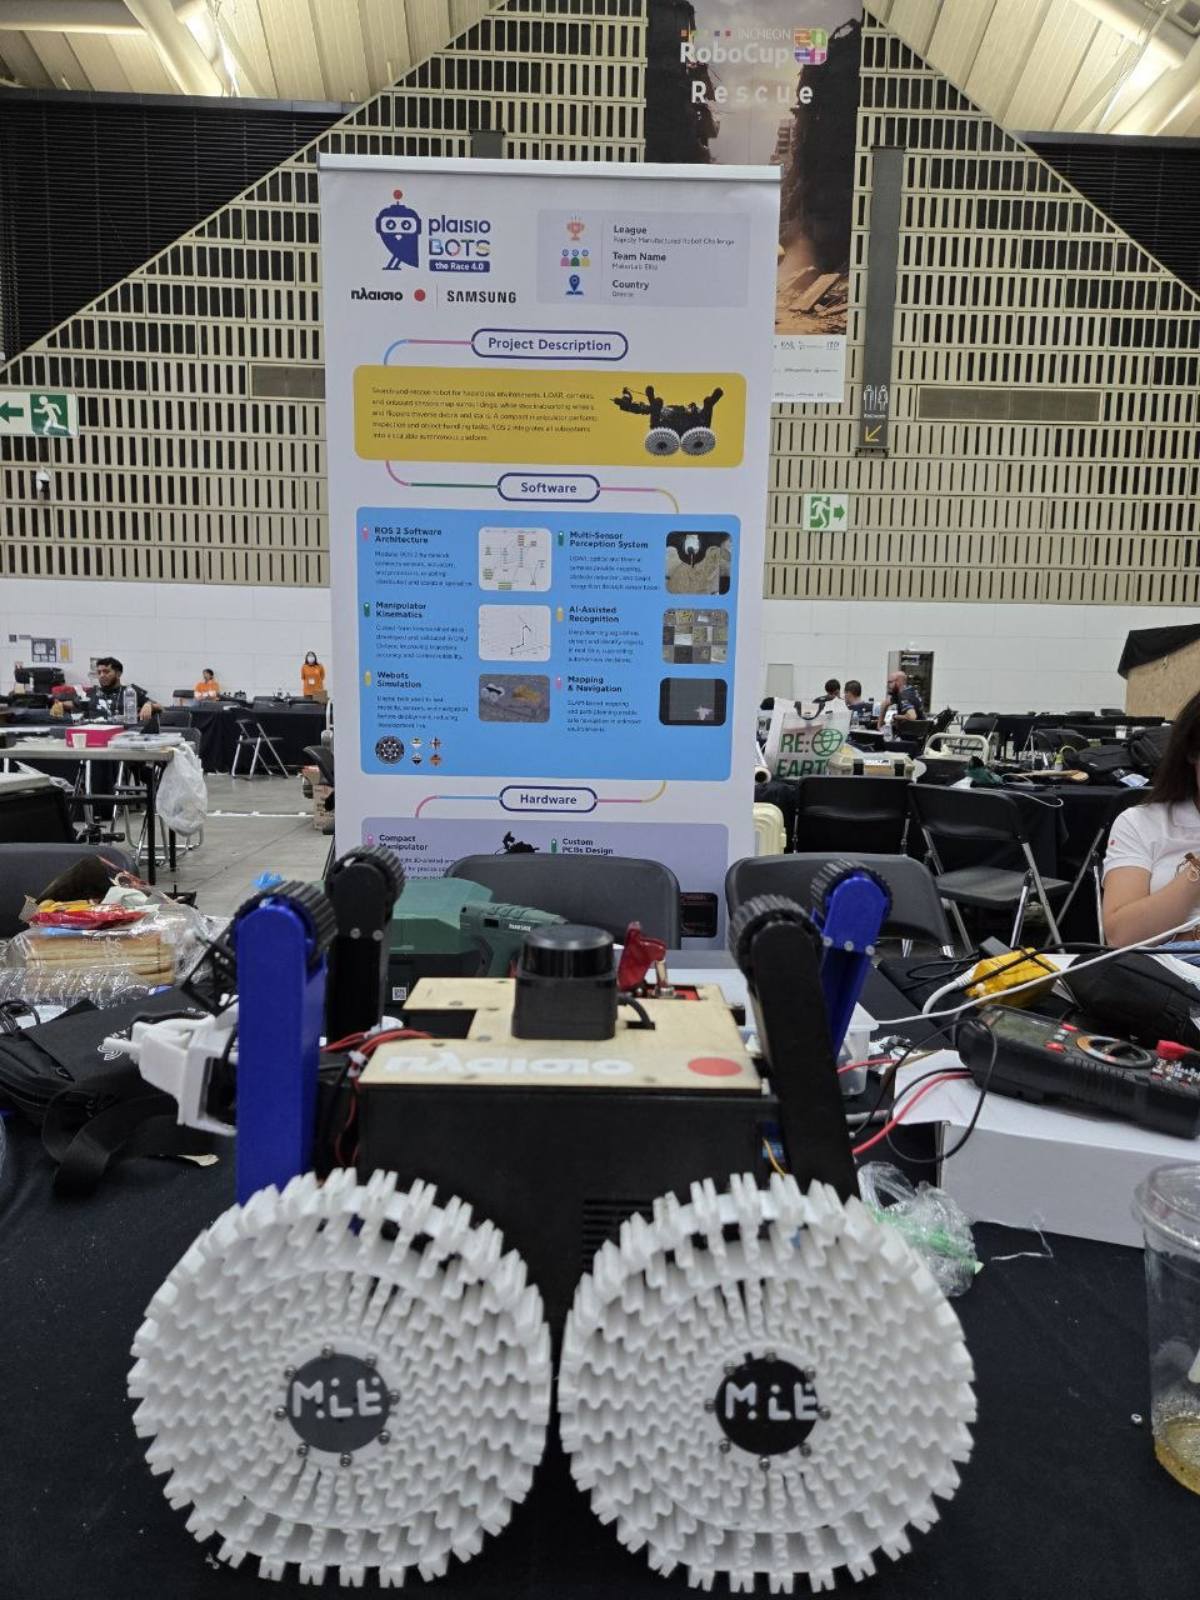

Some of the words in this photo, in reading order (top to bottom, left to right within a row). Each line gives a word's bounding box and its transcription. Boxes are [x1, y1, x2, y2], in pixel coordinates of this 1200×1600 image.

[680, 41, 789, 67] RoboCup
[691, 80, 814, 105] Rescue
[428, 215, 491, 236] plaisio
[614, 225, 647, 236] League
[428, 239, 491, 257] BOTS
[613, 252, 637, 260] Team
[639, 253, 667, 262] Name
[435, 262, 448, 270] the
[450, 262, 469, 270] Race
[471, 263, 484, 271] 4.0
[612, 280, 649, 291] Country
[447, 290, 517, 304] SAMSUNG
[488, 337, 534, 351] Project
[538, 340, 611, 353] Description
[520, 481, 577, 493] Software
[374, 527, 394, 535] ROS
[396, 527, 401, 535] 2
[404, 527, 442, 536] Software
[569, 531, 624, 540] Multi-Sensor
[375, 535, 429, 544] Architecture
[569, 540, 616, 549] Perception
[618, 541, 649, 550] System
[376, 601, 427, 611] Manipulator
[569, 606, 617, 614] AI-Assisted
[376, 610, 423, 618] Kinematics
[569, 614, 620, 624] Recognition
[377, 671, 409, 680] Webots
[568, 675, 604, 684] Mapping
[377, 680, 422, 688] Simulation
[576, 685, 622, 693] Navigation
[780, 733, 809, 753] RE:
[776, 759, 829, 777] EART
[520, 794, 577, 805] Hardware
[379, 834, 416, 842] Compact
[562, 838, 593, 846] Custom
[585, 847, 613, 856] Design
